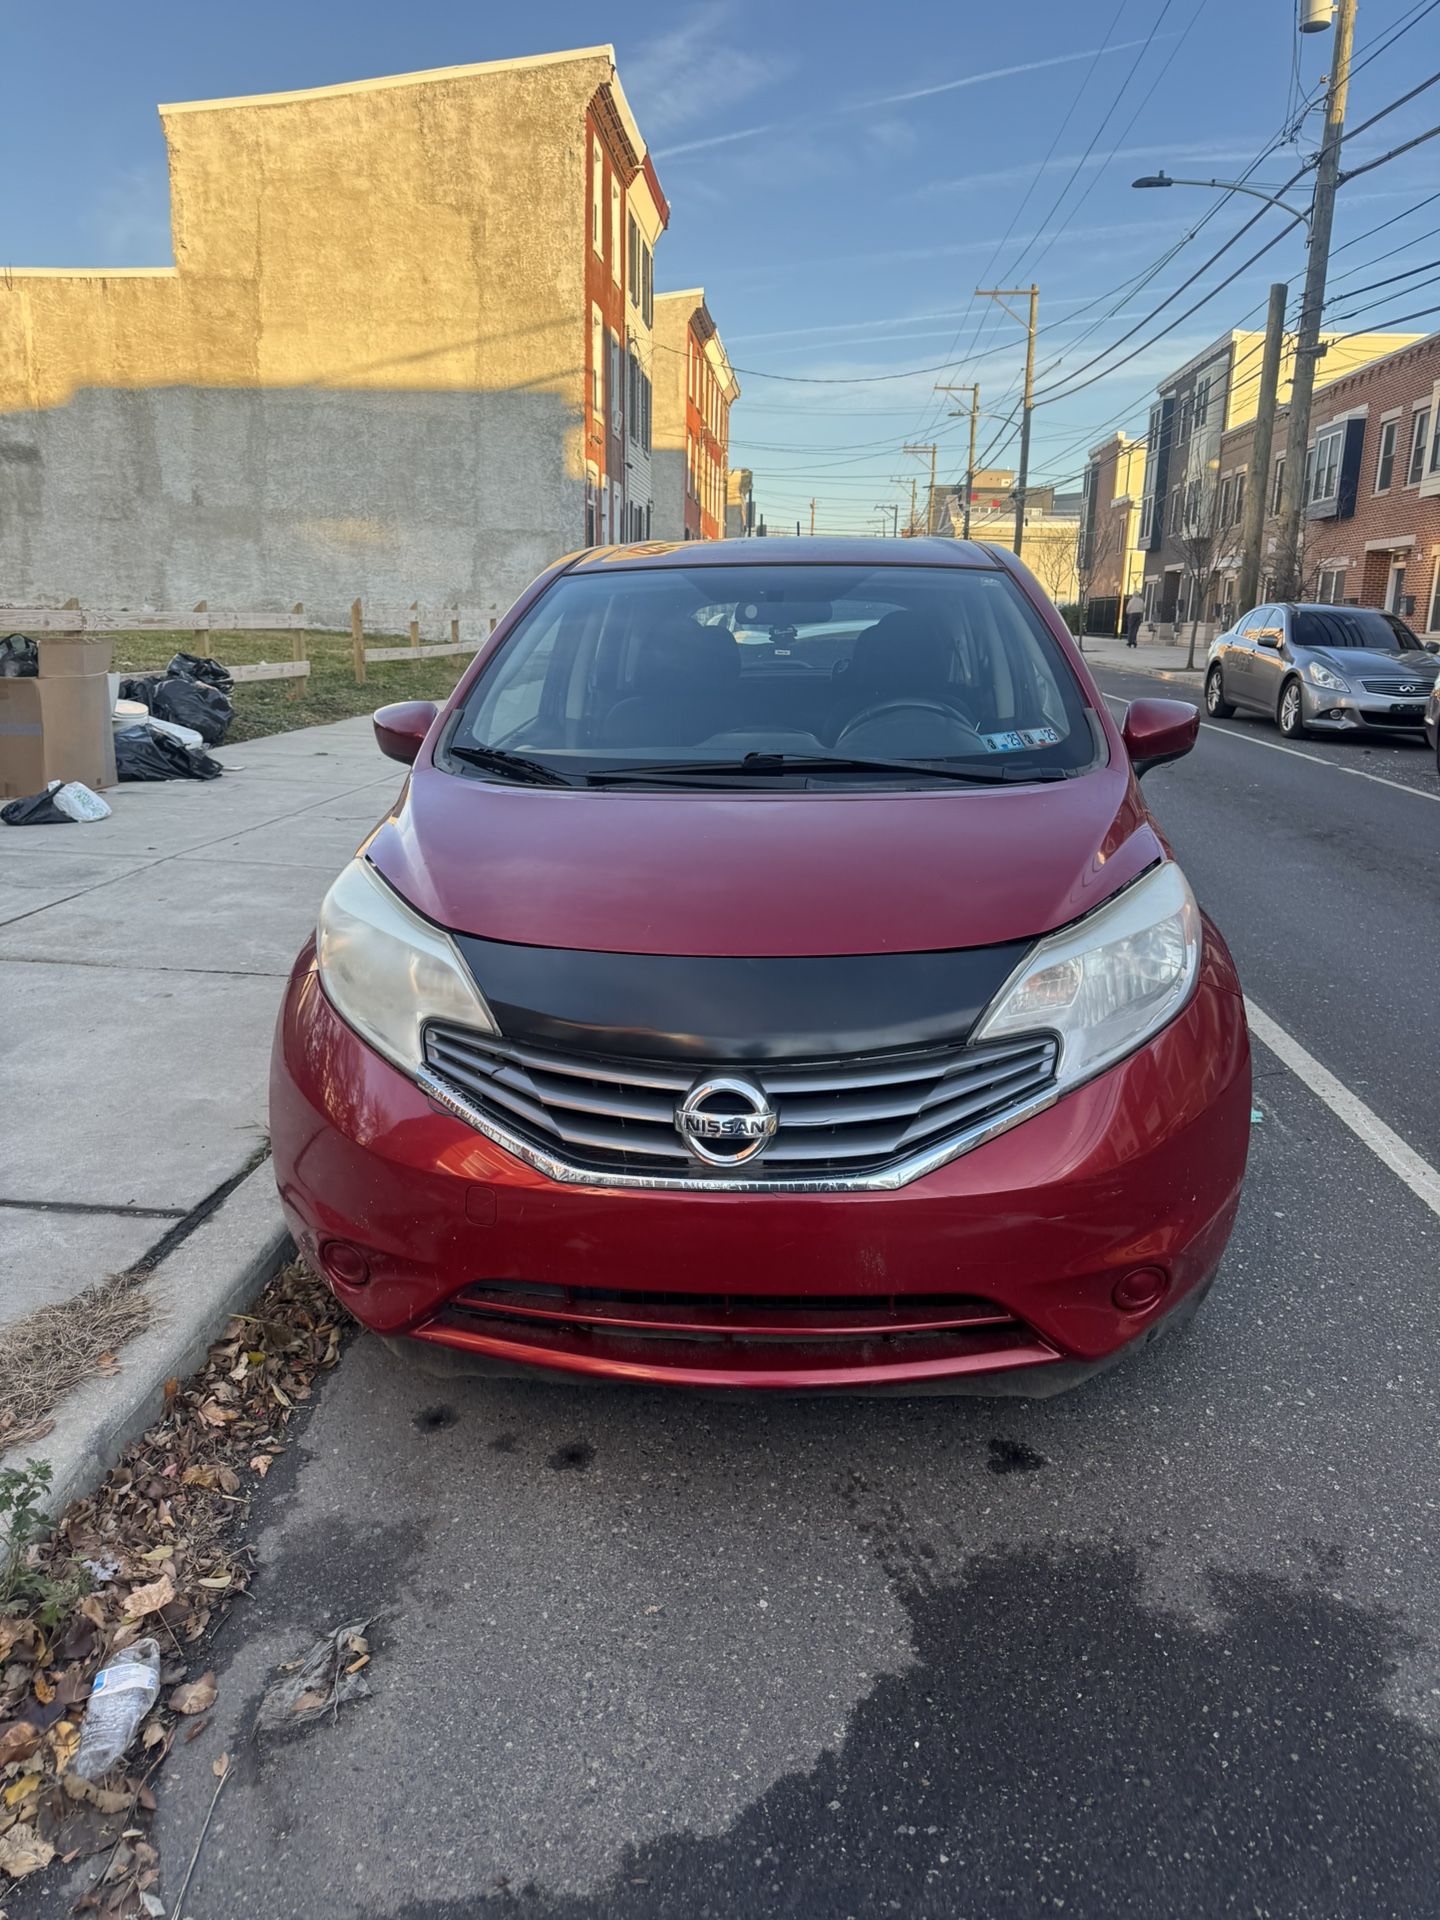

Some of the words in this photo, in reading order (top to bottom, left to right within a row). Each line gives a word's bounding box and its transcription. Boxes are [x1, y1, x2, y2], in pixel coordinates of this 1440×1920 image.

[1007, 733, 1021, 746] 25
[1044, 728, 1058, 741] 25
[685, 1118, 765, 1134] NISSAN
